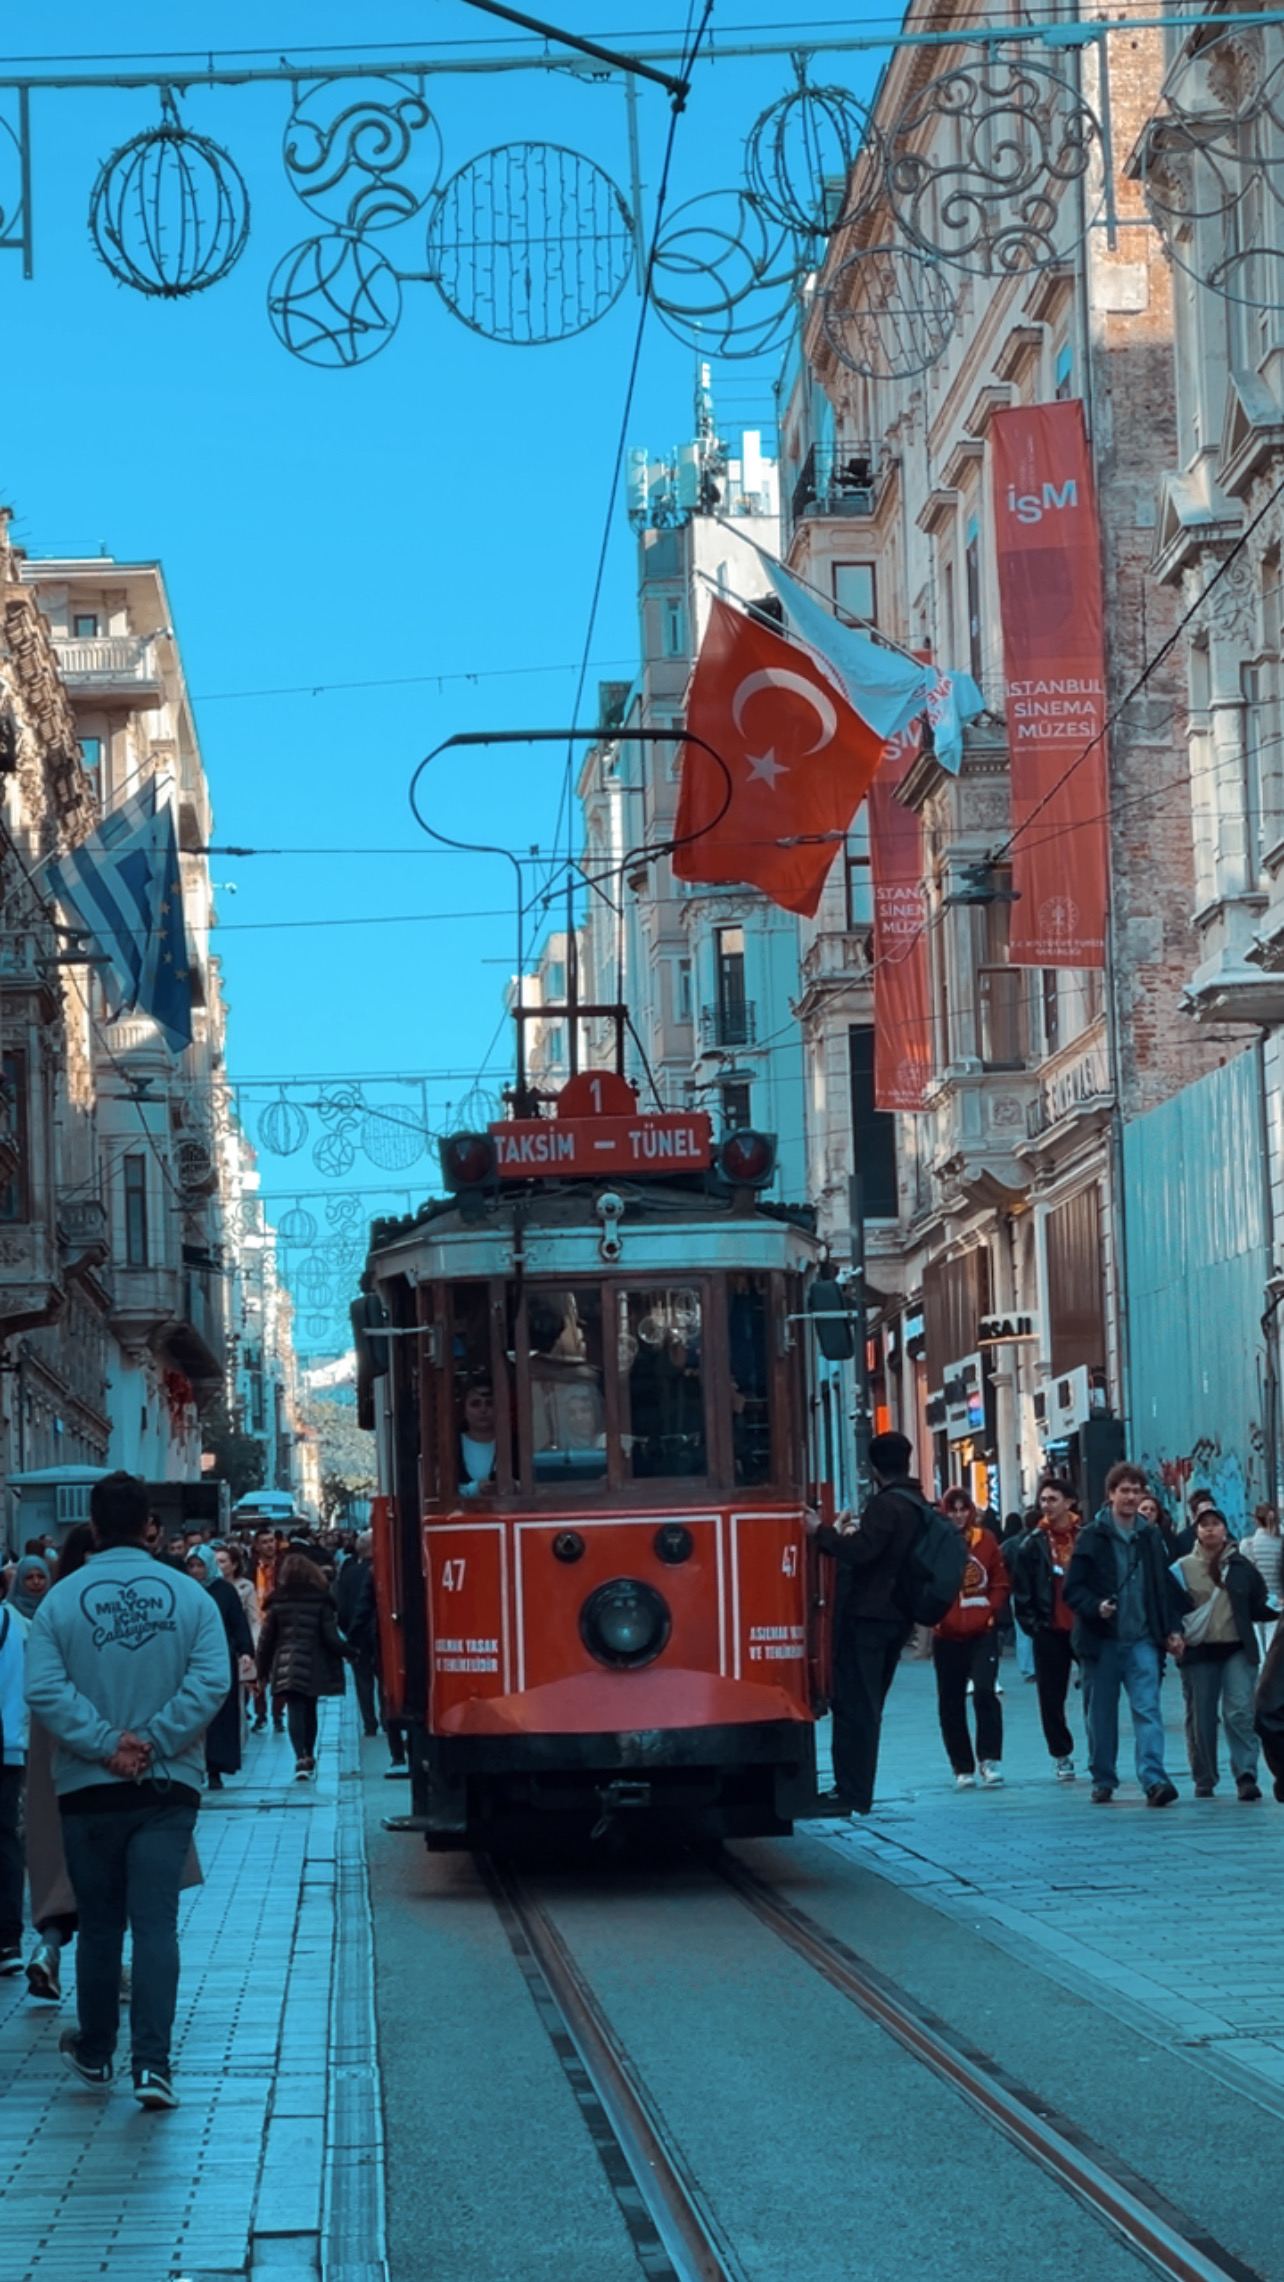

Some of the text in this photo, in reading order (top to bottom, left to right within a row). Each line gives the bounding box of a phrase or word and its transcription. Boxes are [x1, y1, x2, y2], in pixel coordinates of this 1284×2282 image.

[1013, 698, 1098, 718] SİNEMA
[1017, 717, 1097, 739] MÜZESİ
[589, 1078, 602, 1113] 1
[494, 1128, 576, 1164] TAKSİM
[629, 1122, 702, 1160] TÜNEL
[783, 1545, 798, 1577] 47
[442, 1559, 466, 1591] 47
[117, 1588, 138, 1601] 16
[465, 1639, 498, 1653] YASAK
